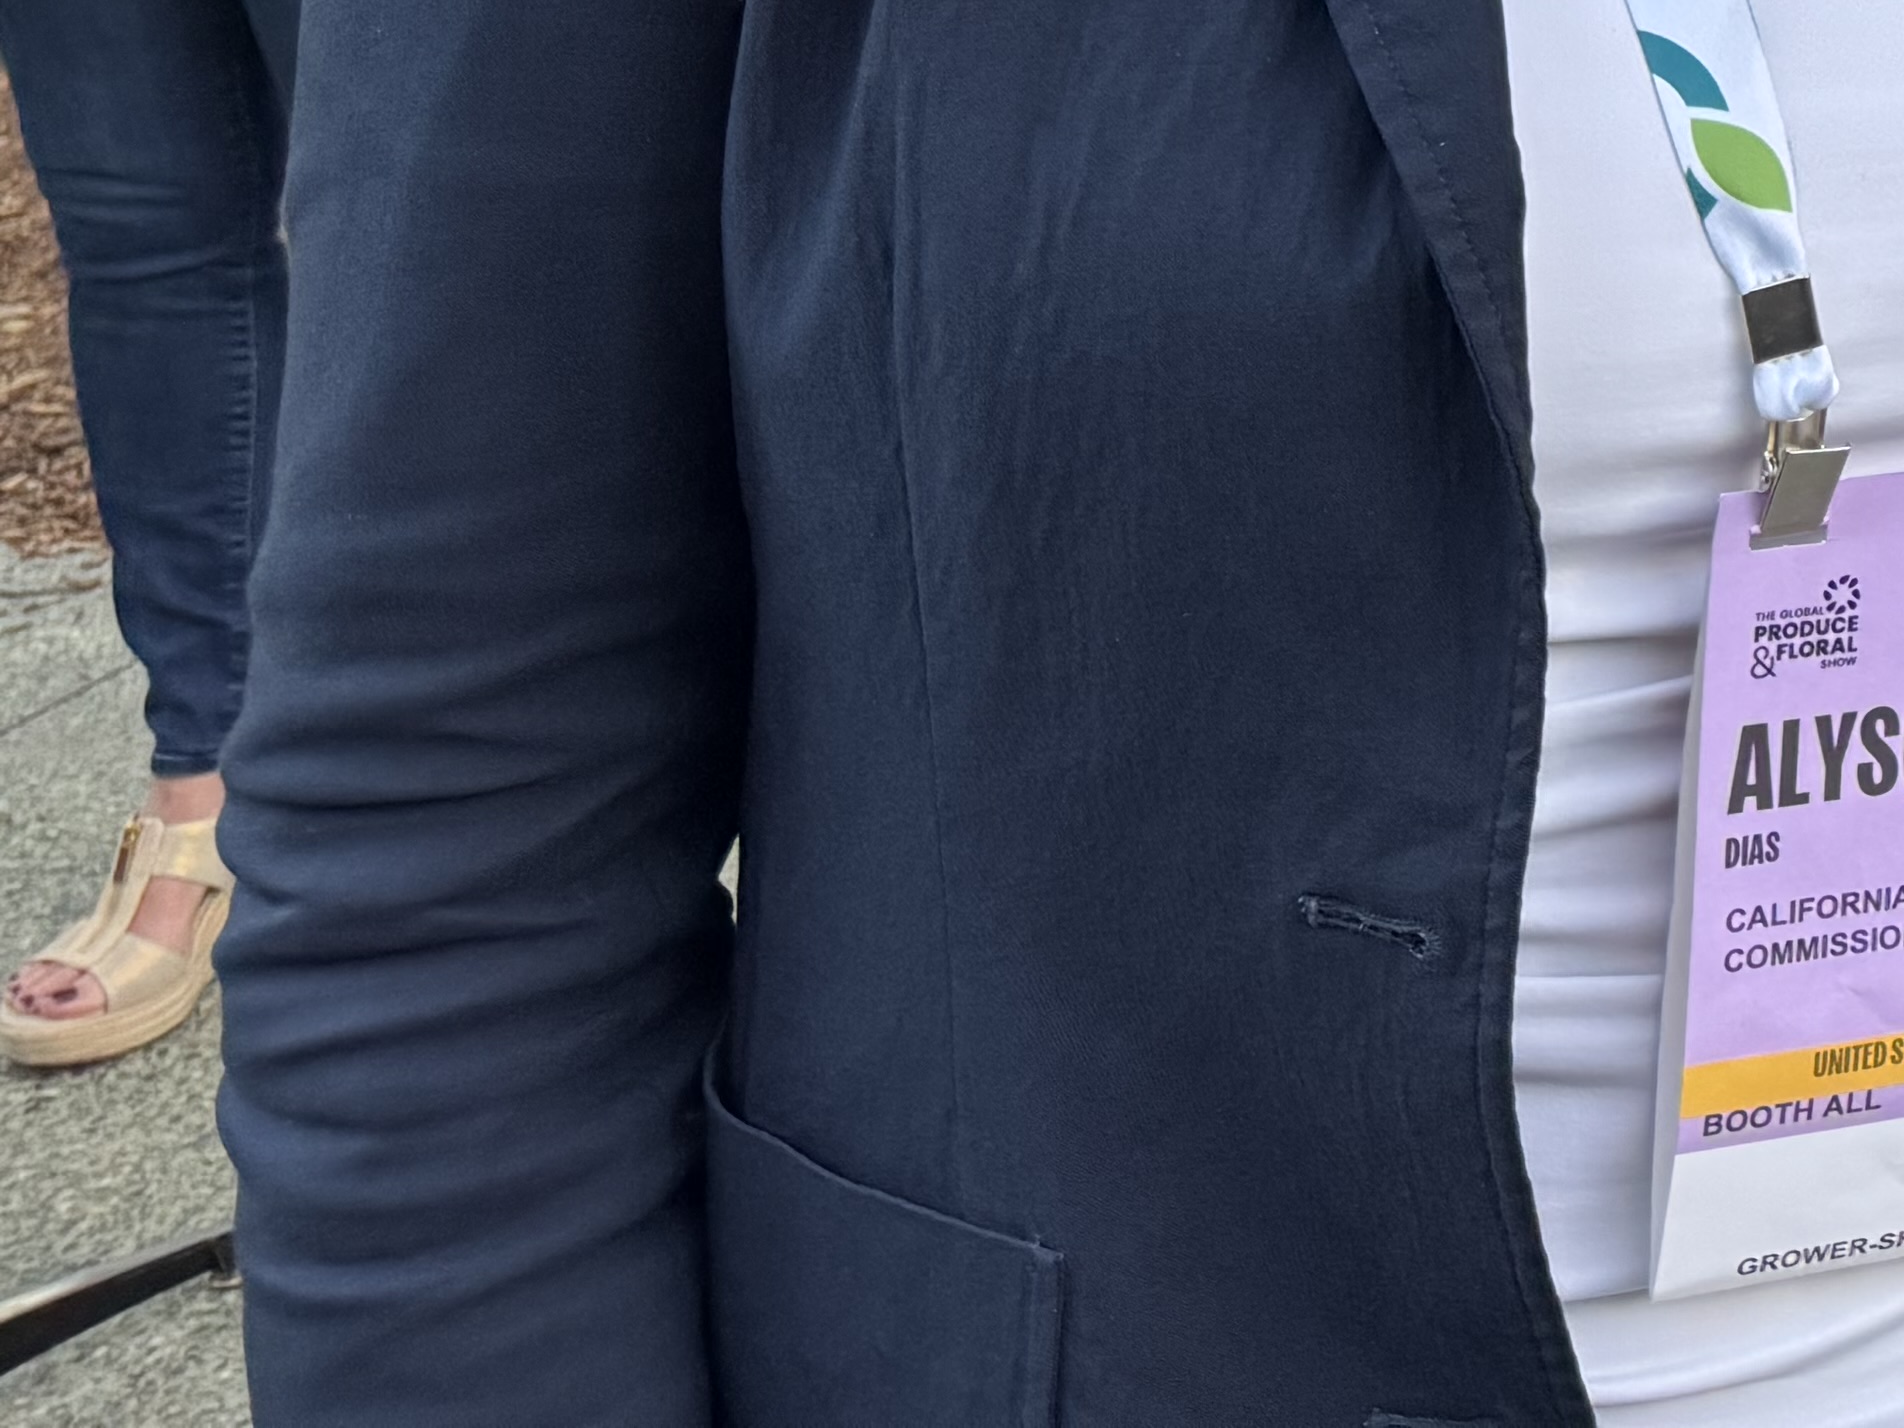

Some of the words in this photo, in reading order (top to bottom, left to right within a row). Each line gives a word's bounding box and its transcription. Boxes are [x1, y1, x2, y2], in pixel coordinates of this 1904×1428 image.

[1753, 615, 1860, 643] PRODUCE
[1755, 611, 1777, 624] THE
[1778, 606, 1824, 621] GLOBAL
[1749, 646, 1777, 680] &
[1776, 636, 1858, 662] FLORAL
[1819, 656, 1858, 670] SHOW
[1724, 831, 1781, 870] DIAS
[1812, 1037, 1887, 1079] UNITED
[1702, 1097, 1814, 1138] BOOTH
[1822, 1088, 1882, 1119] ALL
